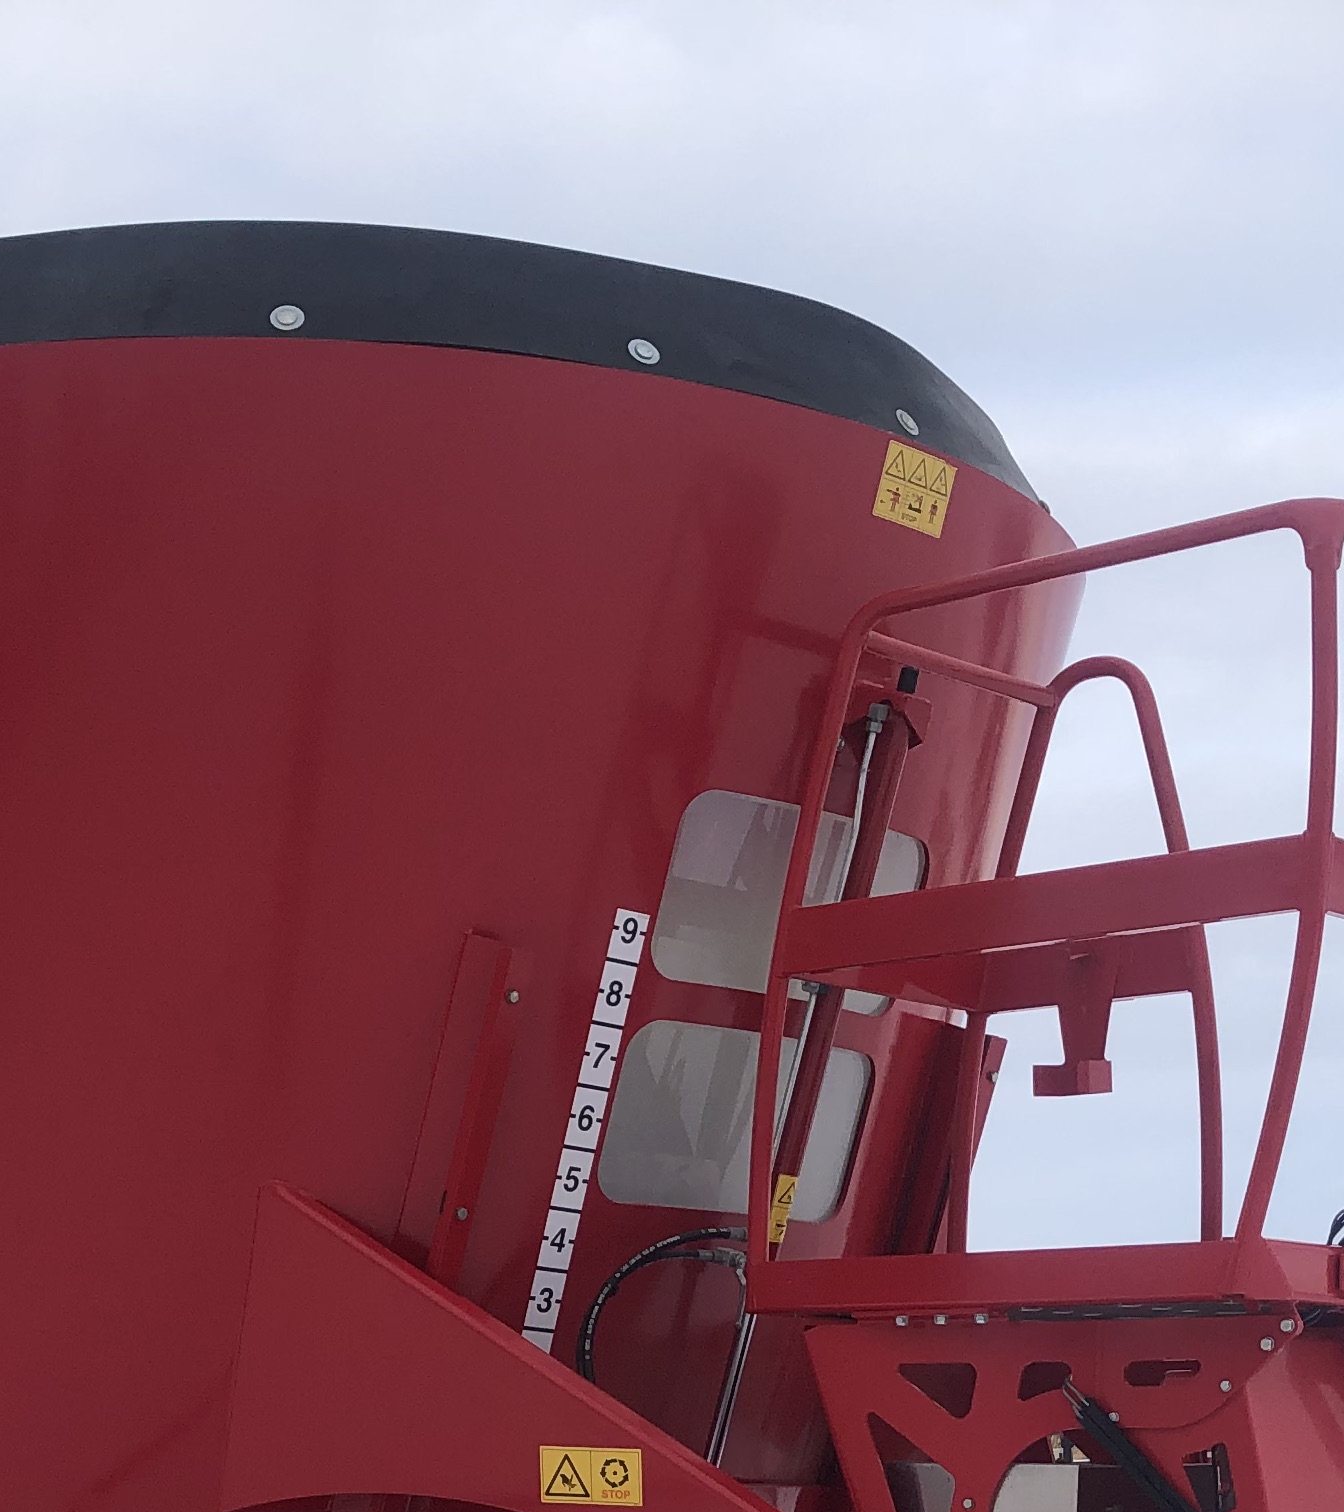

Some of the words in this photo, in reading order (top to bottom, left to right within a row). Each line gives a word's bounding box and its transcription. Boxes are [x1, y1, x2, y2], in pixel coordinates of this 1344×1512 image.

[620, 917, 639, 944] 9
[605, 980, 623, 1007] 8
[592, 1042, 611, 1069] 7
[577, 1104, 595, 1132] 6
[563, 1166, 582, 1193] 5
[549, 1227, 567, 1253] 4
[536, 1287, 554, 1313] 3
[601, 1489, 631, 1500] STOP
